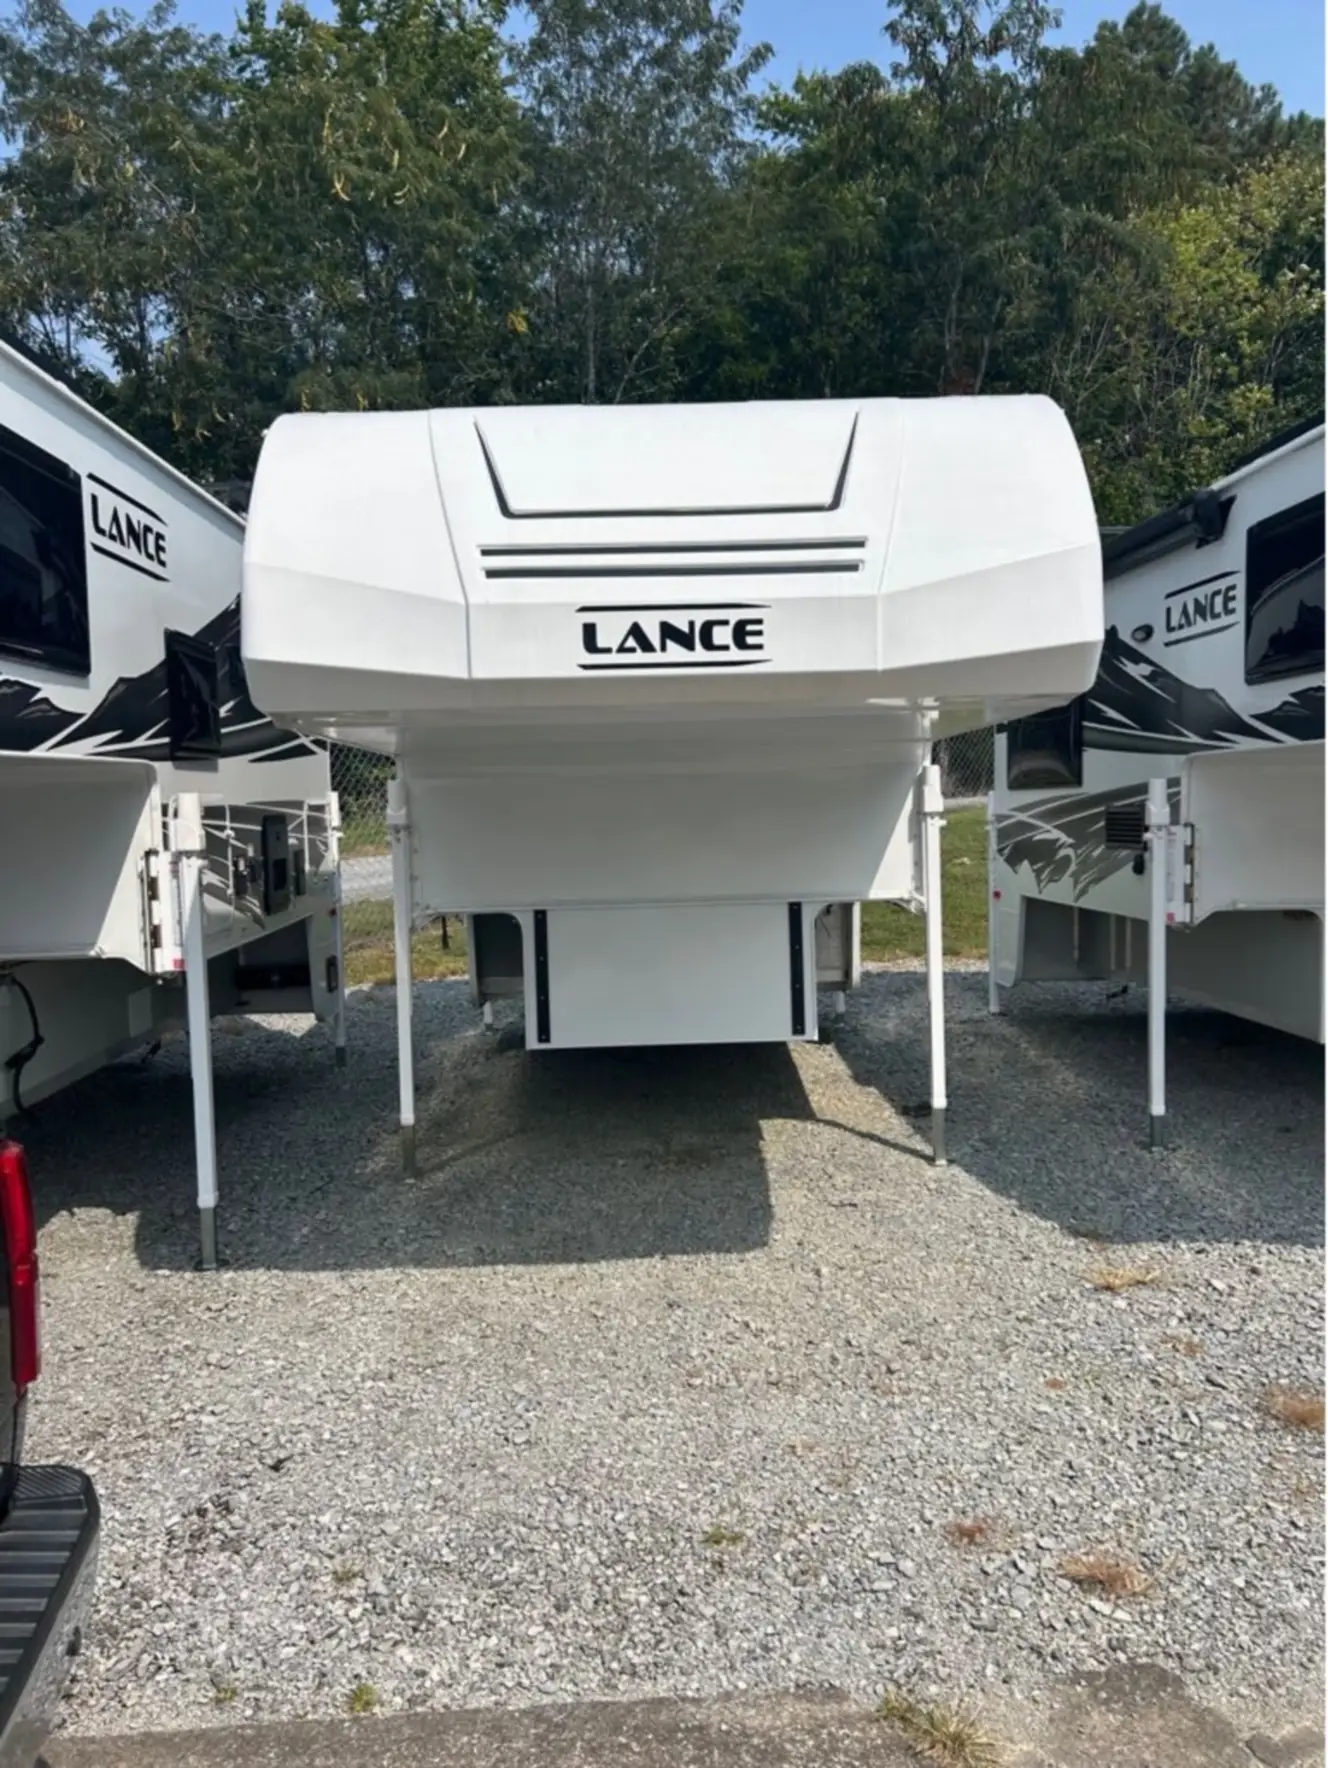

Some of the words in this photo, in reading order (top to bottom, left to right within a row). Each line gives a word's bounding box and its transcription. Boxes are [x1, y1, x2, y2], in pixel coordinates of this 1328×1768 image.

[91, 493, 167, 569] LANCE
[1165, 583, 1237, 634] LANCE
[582, 618, 764, 654] LANCE
